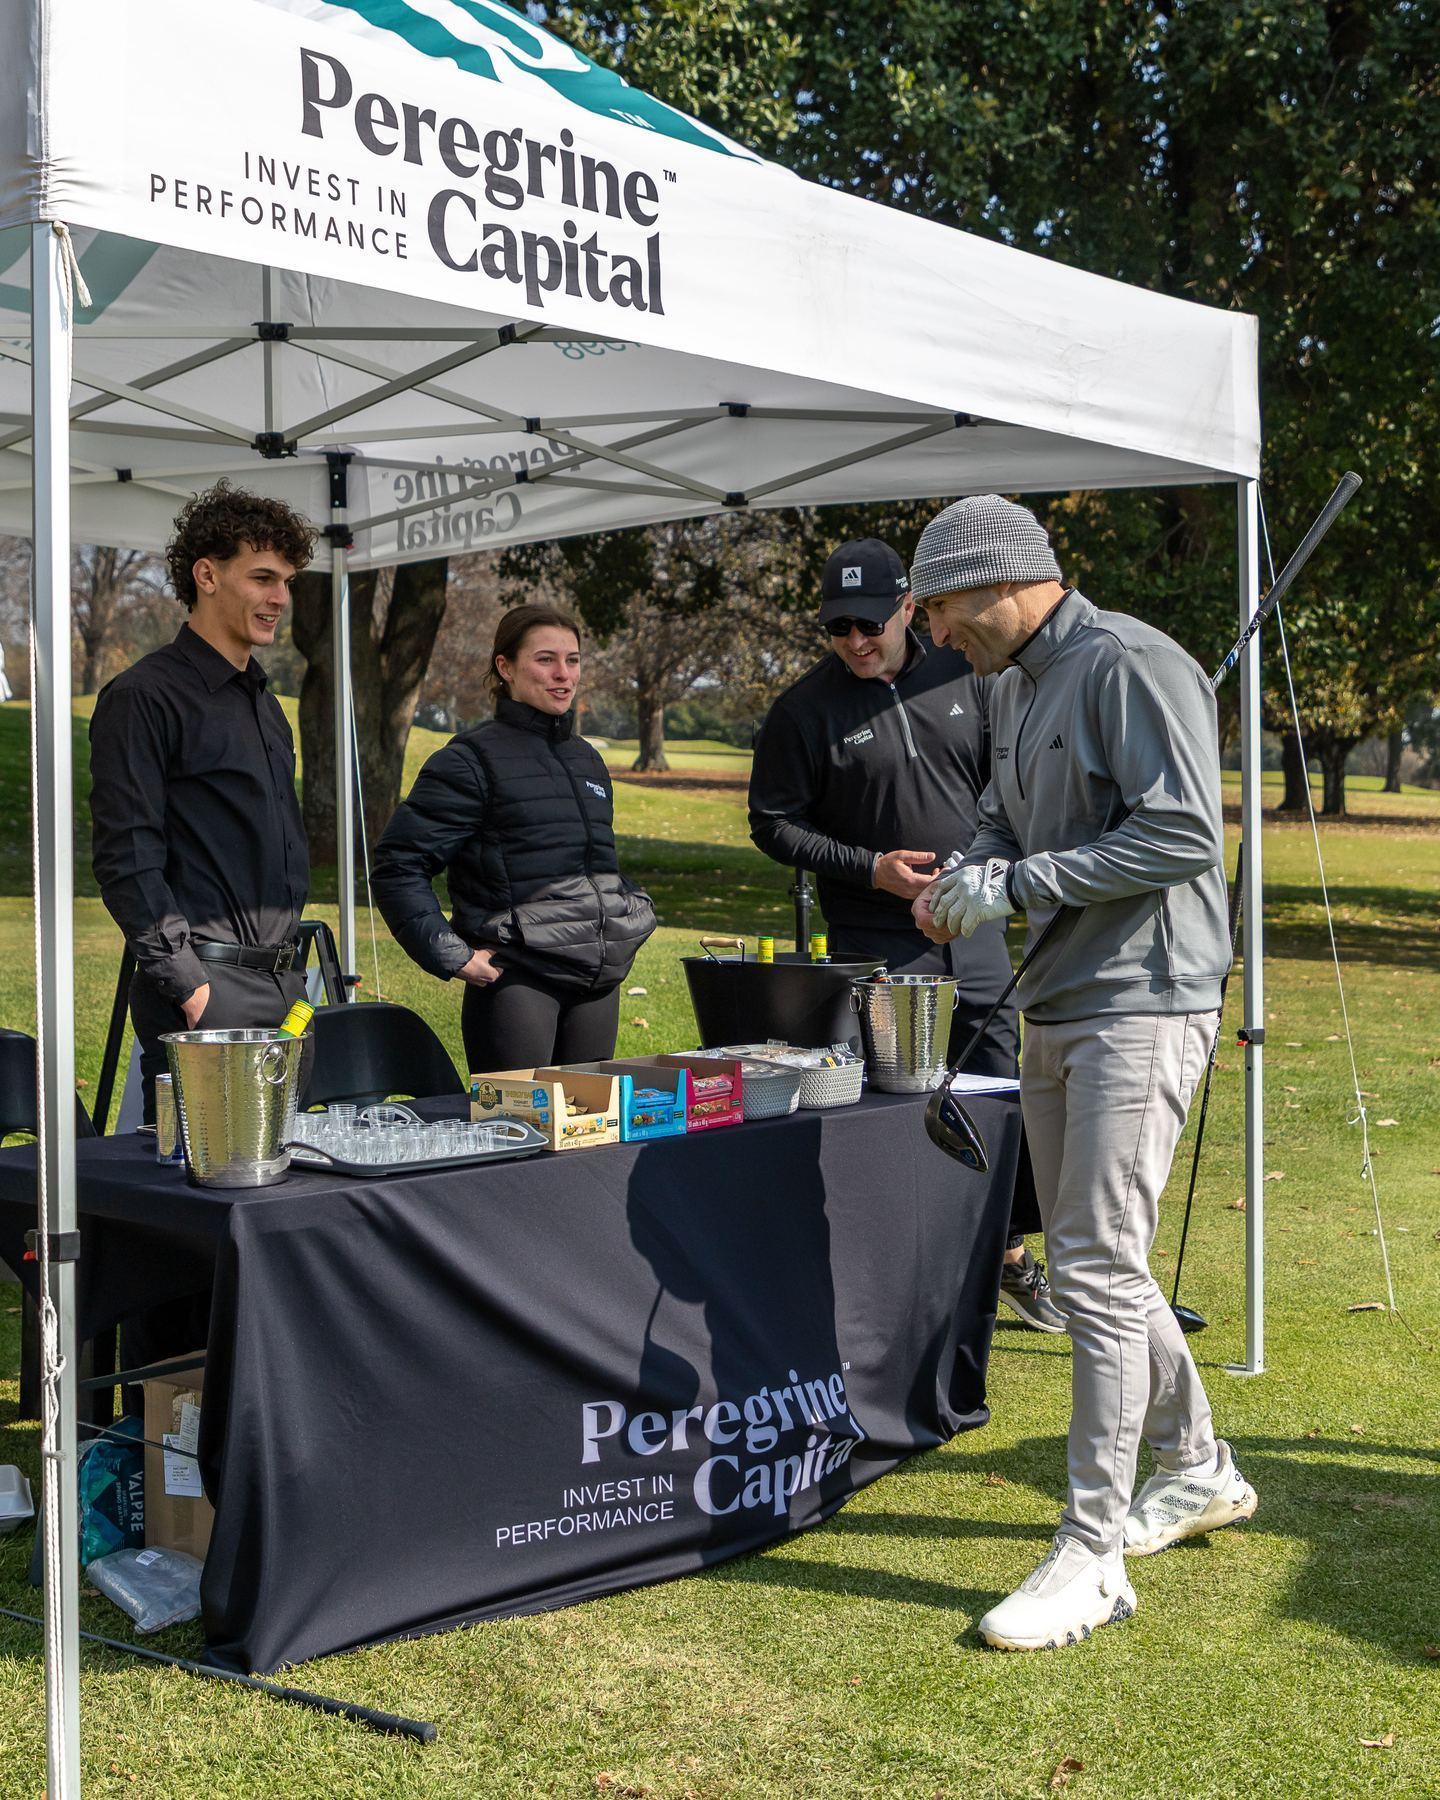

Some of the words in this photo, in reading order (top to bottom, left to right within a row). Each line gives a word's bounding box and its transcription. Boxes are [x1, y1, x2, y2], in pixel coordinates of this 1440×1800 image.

[300, 46, 660, 227] Peregrine
[150, 172, 408, 260] PERFORMANCE
[244, 151, 360, 206] INVEST
[377, 185, 406, 218] IN
[427, 188, 665, 316] Capital
[581, 1368, 847, 1464] Peregrine
[562, 1477, 646, 1508] INVEST
[652, 1473, 674, 1497] IN
[693, 1413, 866, 1517] Capital
[495, 1500, 675, 1548] PERFORMANCE
